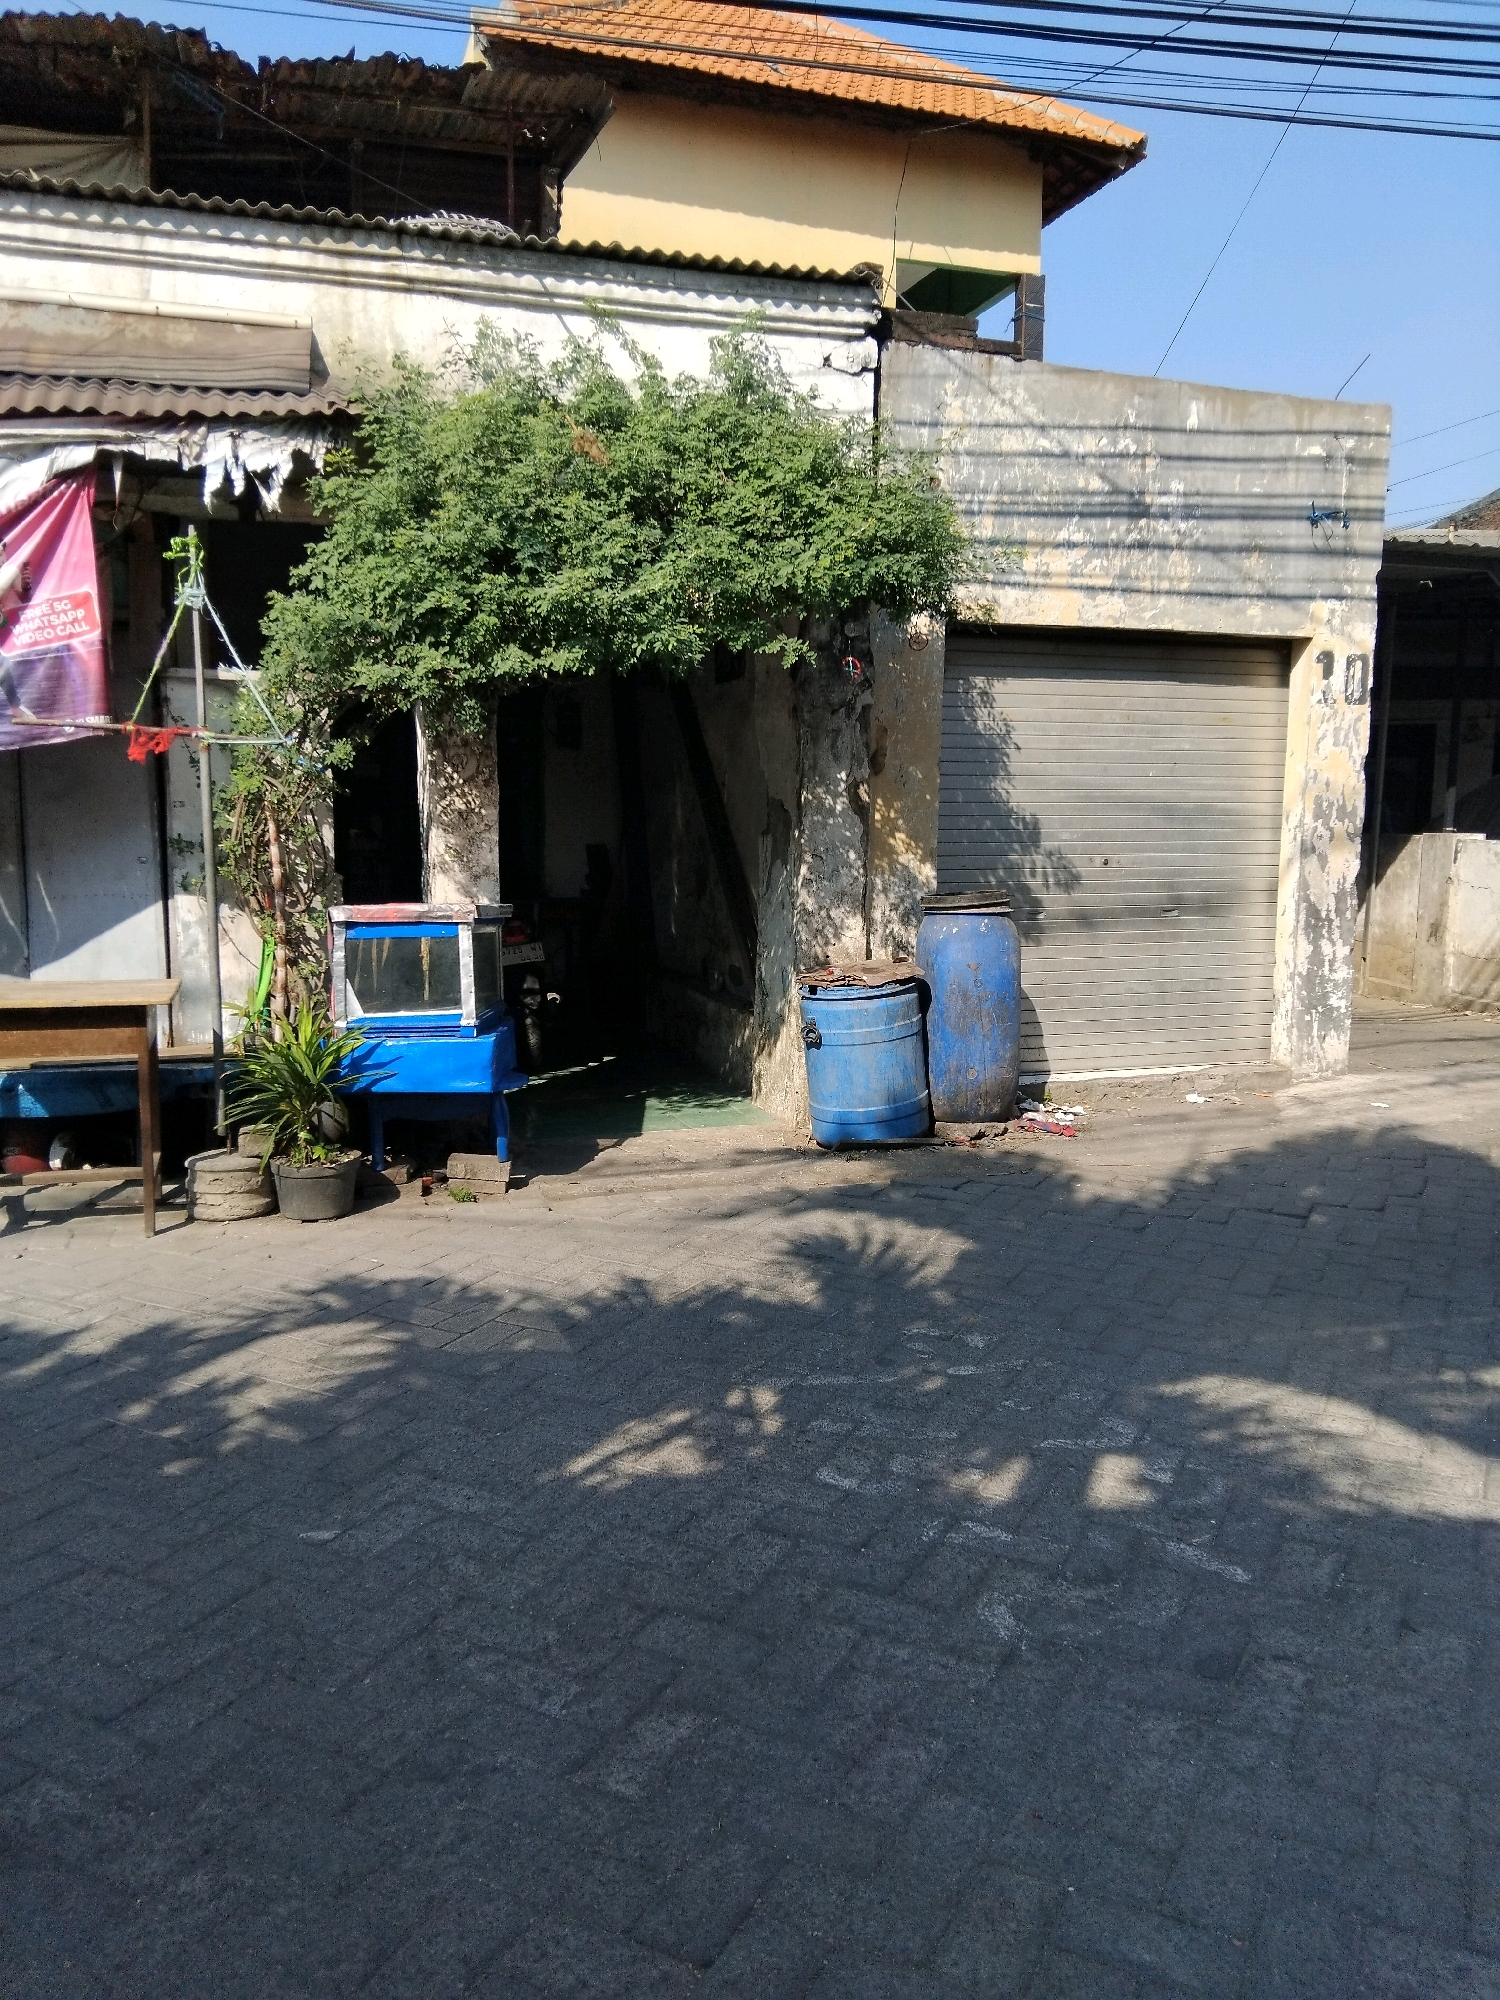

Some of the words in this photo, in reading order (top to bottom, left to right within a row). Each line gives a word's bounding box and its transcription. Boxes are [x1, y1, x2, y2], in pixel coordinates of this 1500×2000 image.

[10, 608, 86, 635] WHATSAPP
[19, 603, 52, 622] FREE
[53, 600, 71, 612] 5G
[13, 628, 55, 647] VIDEO
[56, 621, 90, 636] CALL
[1315, 650, 1370, 706] 10
